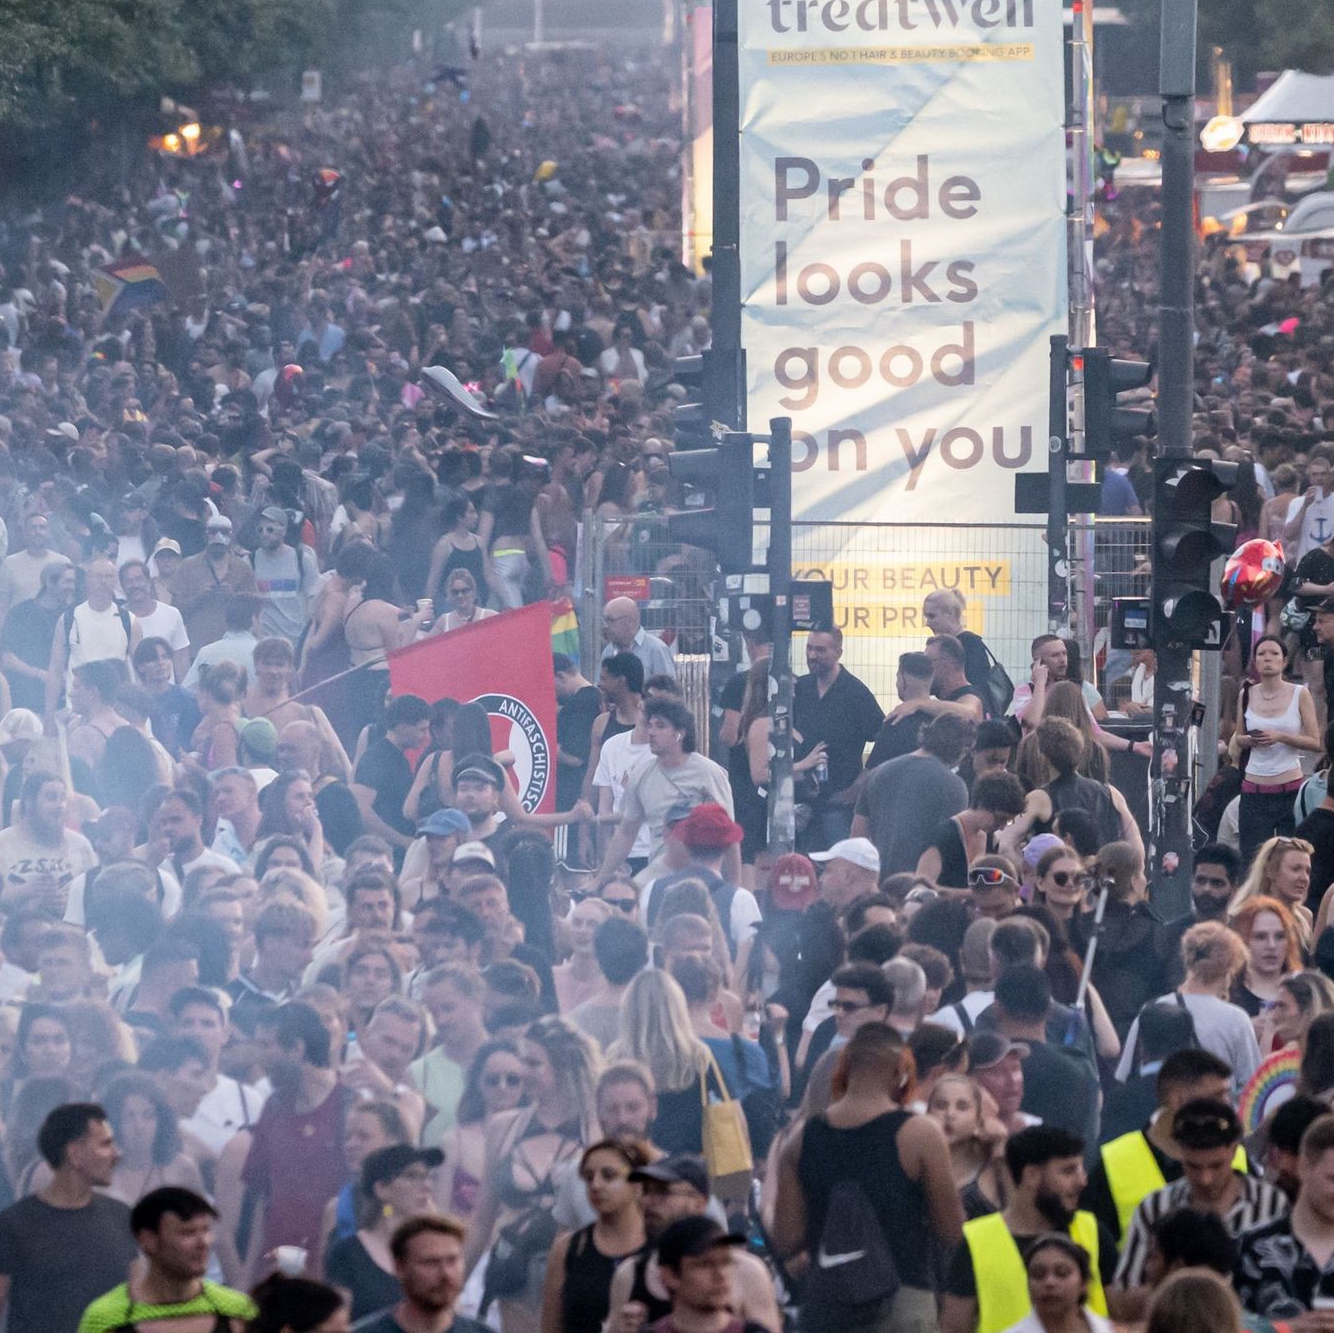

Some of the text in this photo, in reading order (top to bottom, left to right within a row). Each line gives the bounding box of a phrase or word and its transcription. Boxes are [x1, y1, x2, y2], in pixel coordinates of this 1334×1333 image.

[830, 51, 848, 61] NO
[859, 50, 887, 60] HAIR
[890, 49, 897, 59] &
[900, 48, 946, 59] BEAUTY
[1008, 46, 1029, 57] APP
[775, 154, 981, 221] Pride
[775, 239, 979, 305] looks
[774, 321, 975, 410] good
[895, 426, 1032, 491] you
[883, 566, 1003, 590] BEAUTY
[499, 699, 546, 812] ANTIFASCHISTISC
